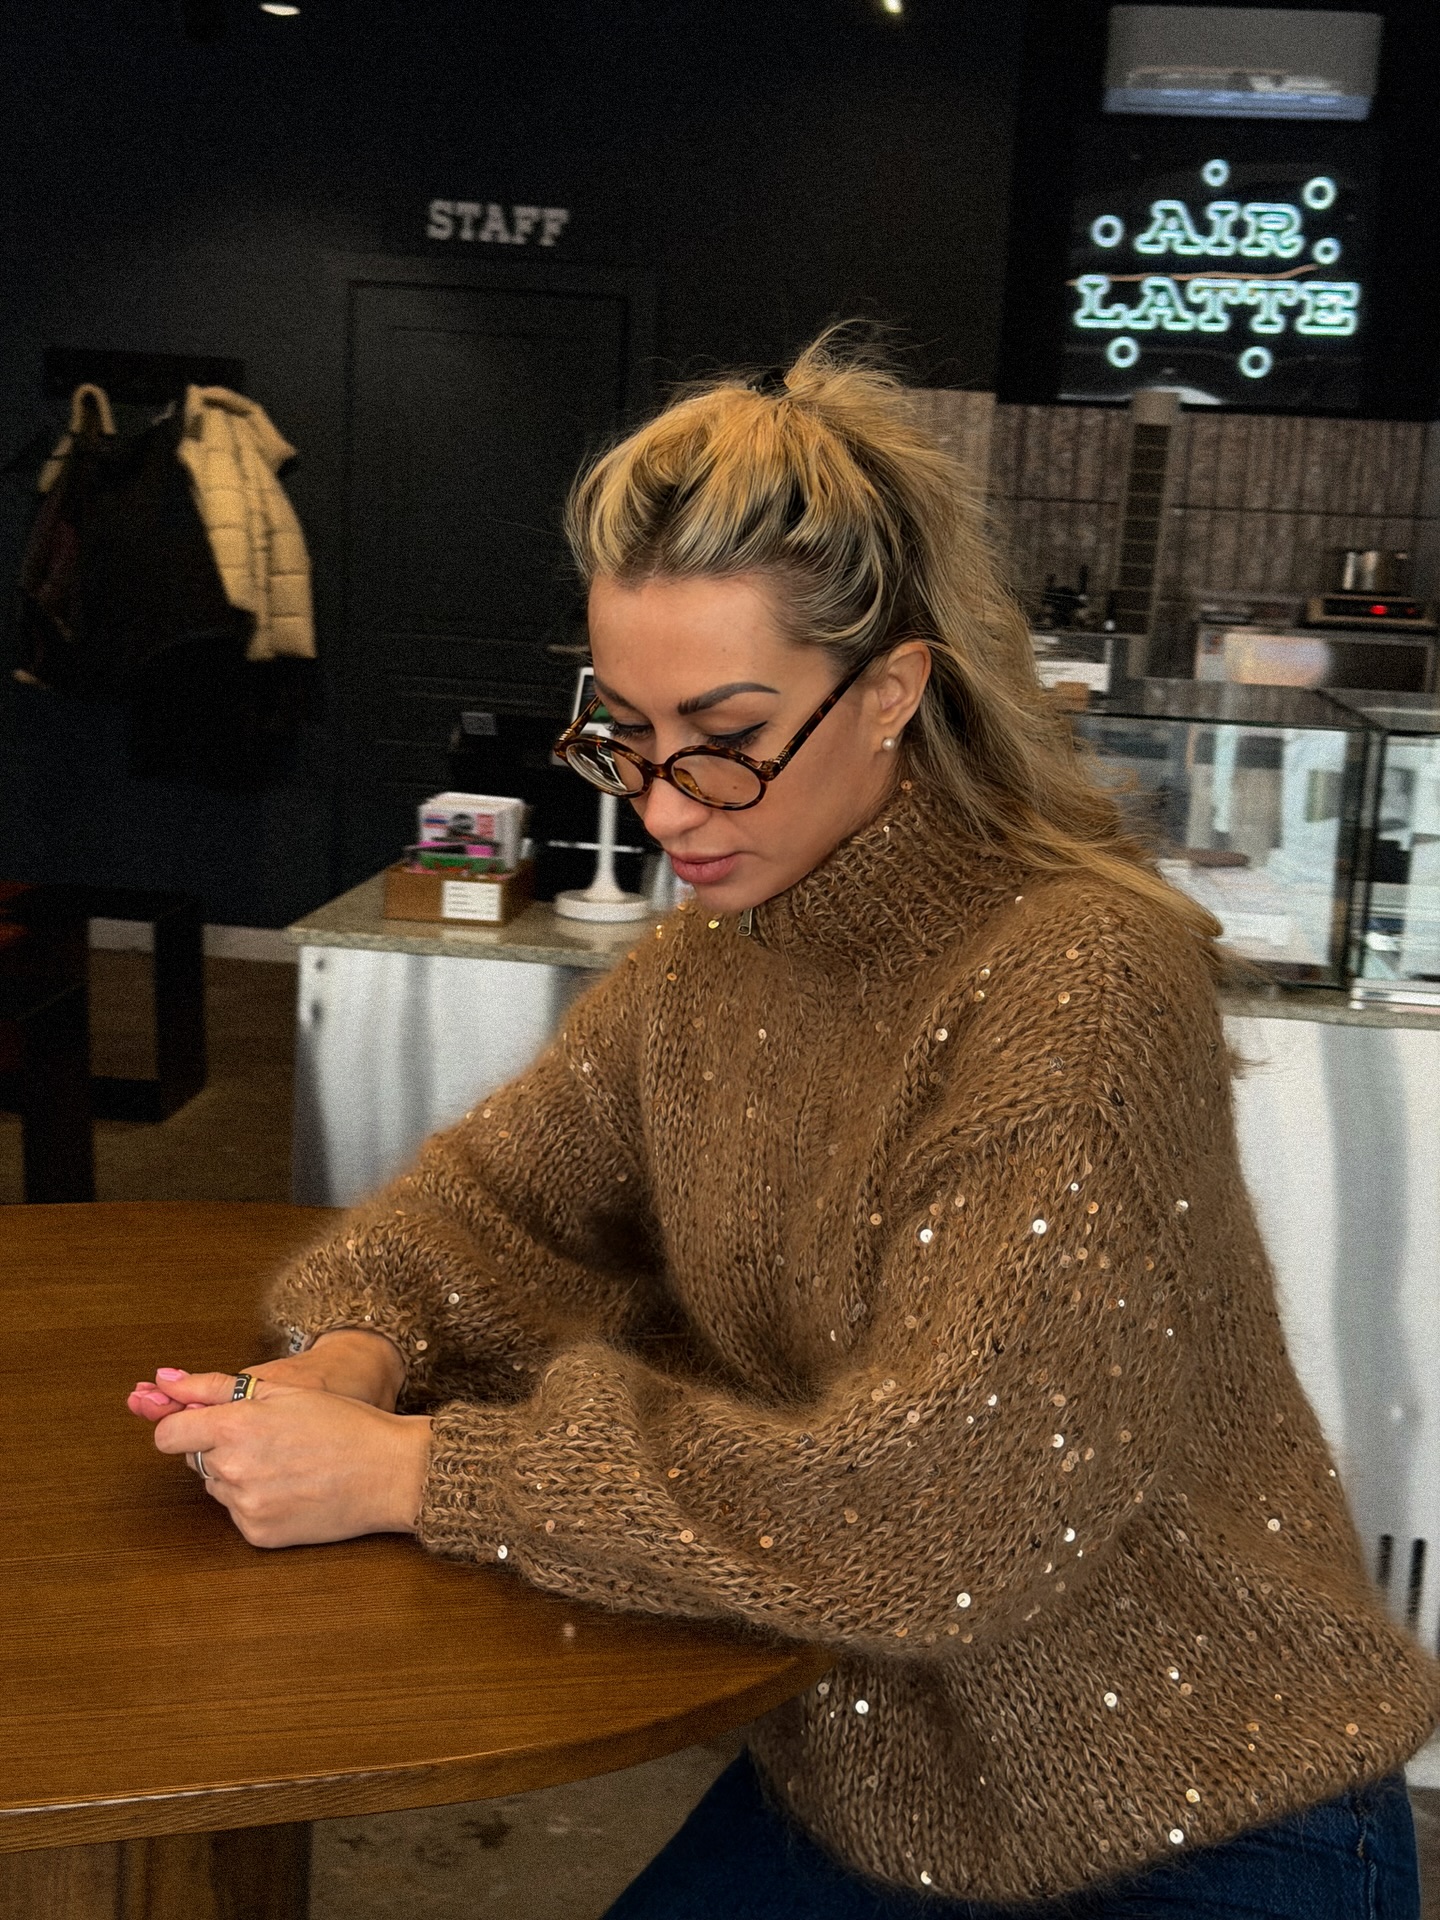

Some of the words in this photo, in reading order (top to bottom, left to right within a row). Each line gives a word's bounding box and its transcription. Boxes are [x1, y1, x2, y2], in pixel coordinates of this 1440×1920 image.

[427, 200, 569, 247] STAFF
[1134, 199, 1304, 257] AIR
[1073, 274, 1360, 336] LATTE
